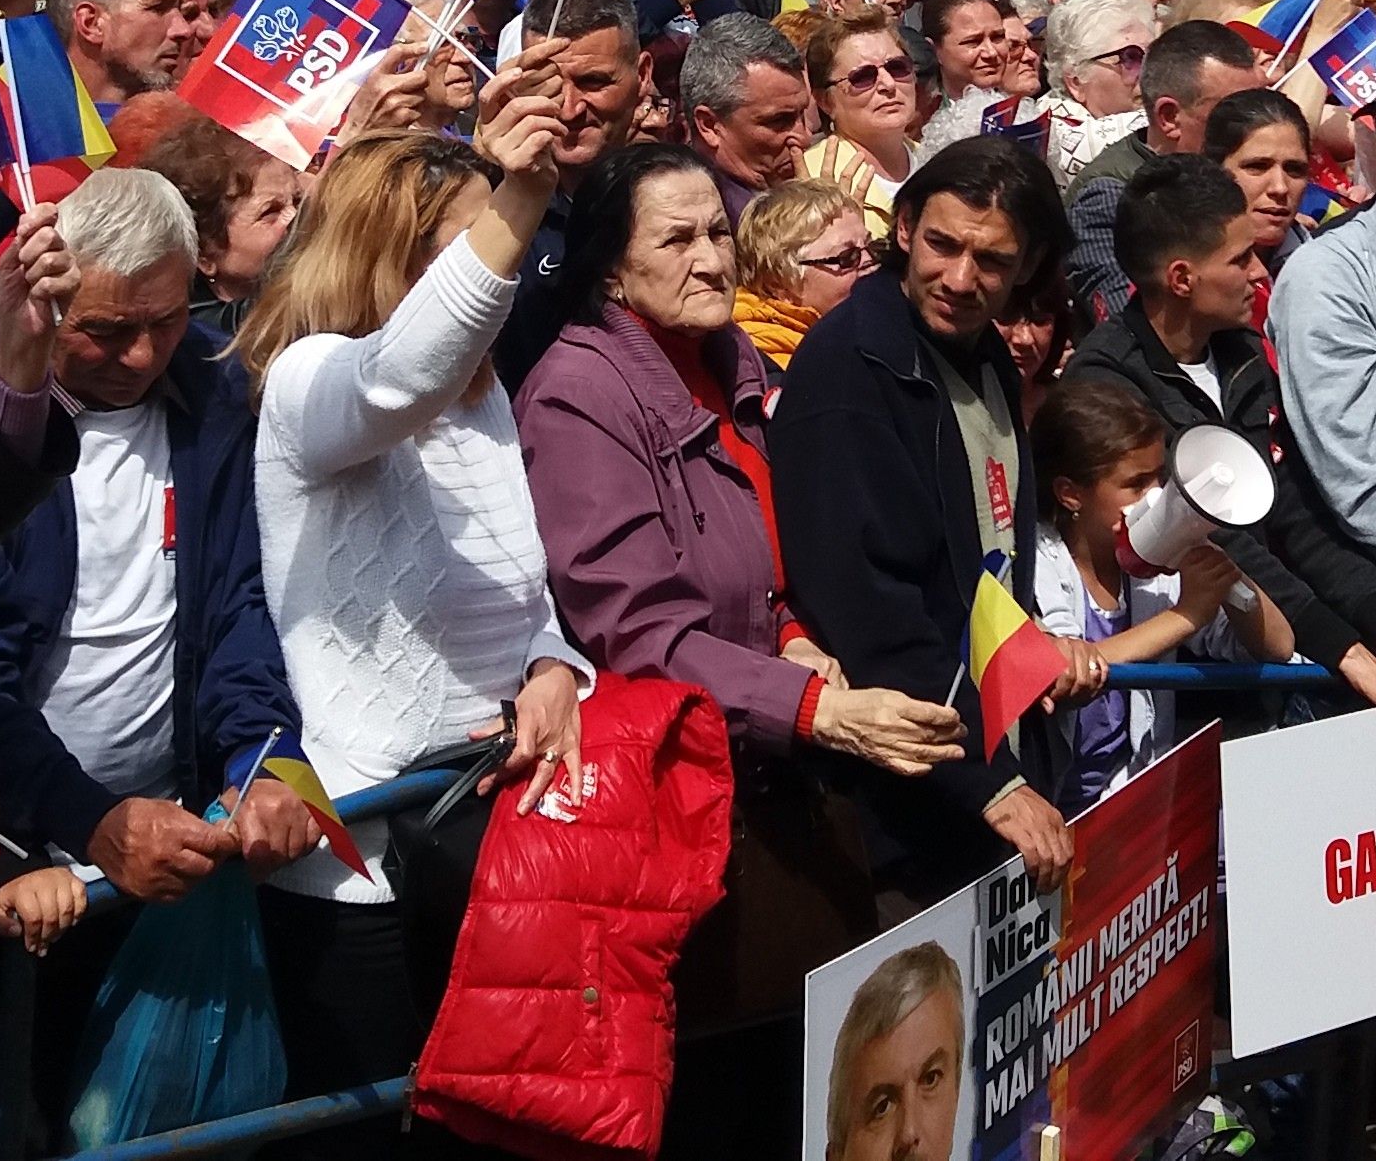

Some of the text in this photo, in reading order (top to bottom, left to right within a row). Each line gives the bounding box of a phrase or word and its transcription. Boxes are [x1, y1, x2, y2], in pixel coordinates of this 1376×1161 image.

[287, 29, 350, 91] PSD
[985, 850, 1180, 1072] ROMÂNII MERITĂ
[986, 907, 1051, 986] Nica
[984, 885, 1210, 1130] MAI MULT RESPECT!
[1177, 1057, 1193, 1082] PSD
